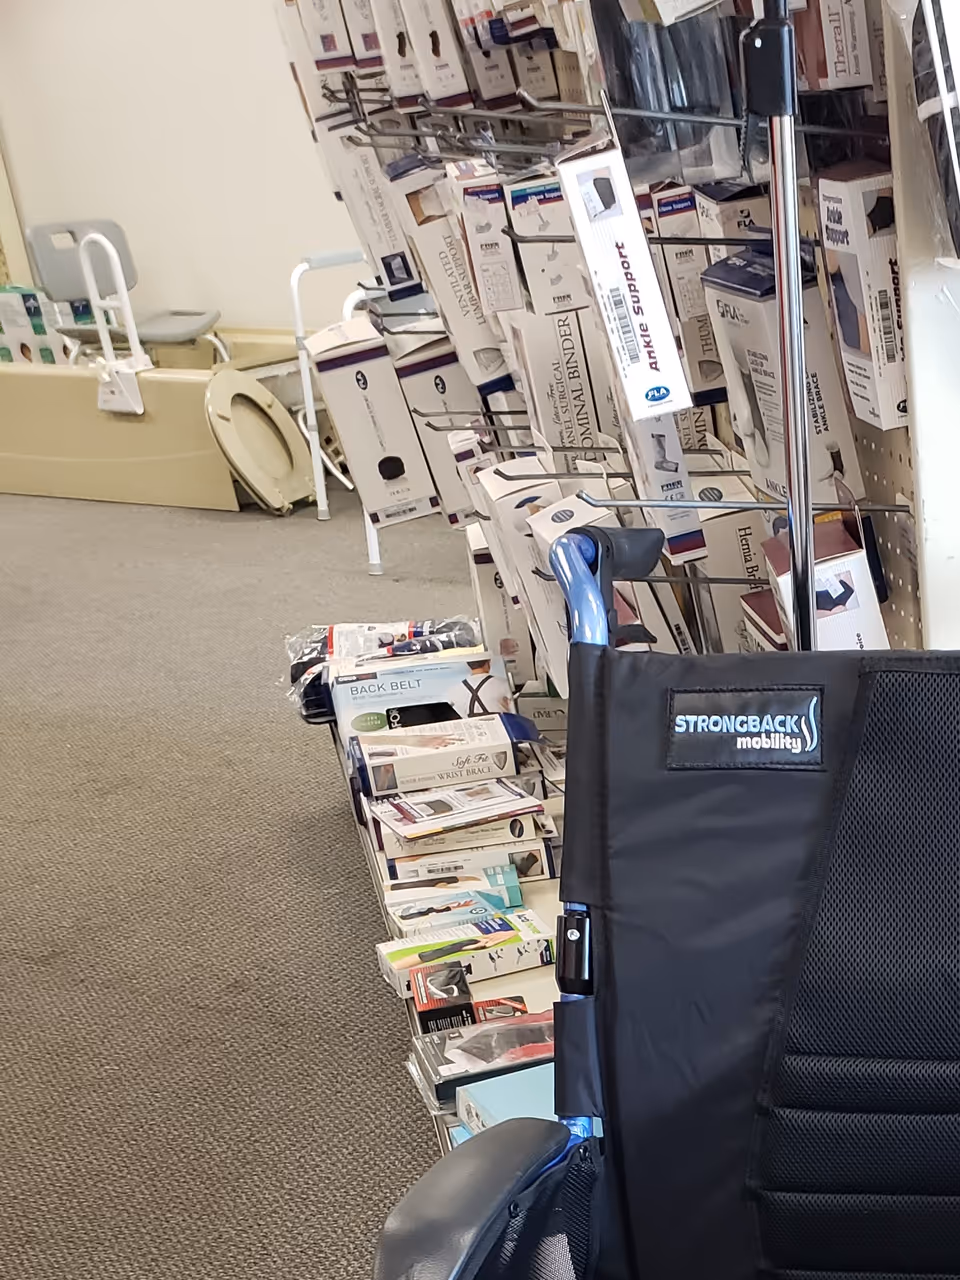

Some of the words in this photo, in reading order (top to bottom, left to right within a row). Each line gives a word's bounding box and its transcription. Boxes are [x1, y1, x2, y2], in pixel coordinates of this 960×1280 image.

[443, 235, 466, 281] SUPPORT
[615, 241, 644, 316] Support
[463, 282, 487, 325] LUMBAR
[558, 315, 581, 380] BINDER
[639, 322, 660, 372] Ankle
[697, 315, 712, 355] THUM
[811, 372, 822, 402] BRACE
[565, 417, 578, 447] ANEL
[819, 402, 829, 432] ANKLE
[738, 526, 757, 563] Hernia
[350, 683, 387, 696] BACK
[390, 679, 422, 693] BELT
[674, 715, 800, 733] STRONGBACK
[736, 733, 802, 754] mobility
[437, 769, 464, 781] WRIST
[466, 766, 492, 777] BRACE
[452, 754, 472, 769] Soft
[473, 752, 490, 763] Fit
